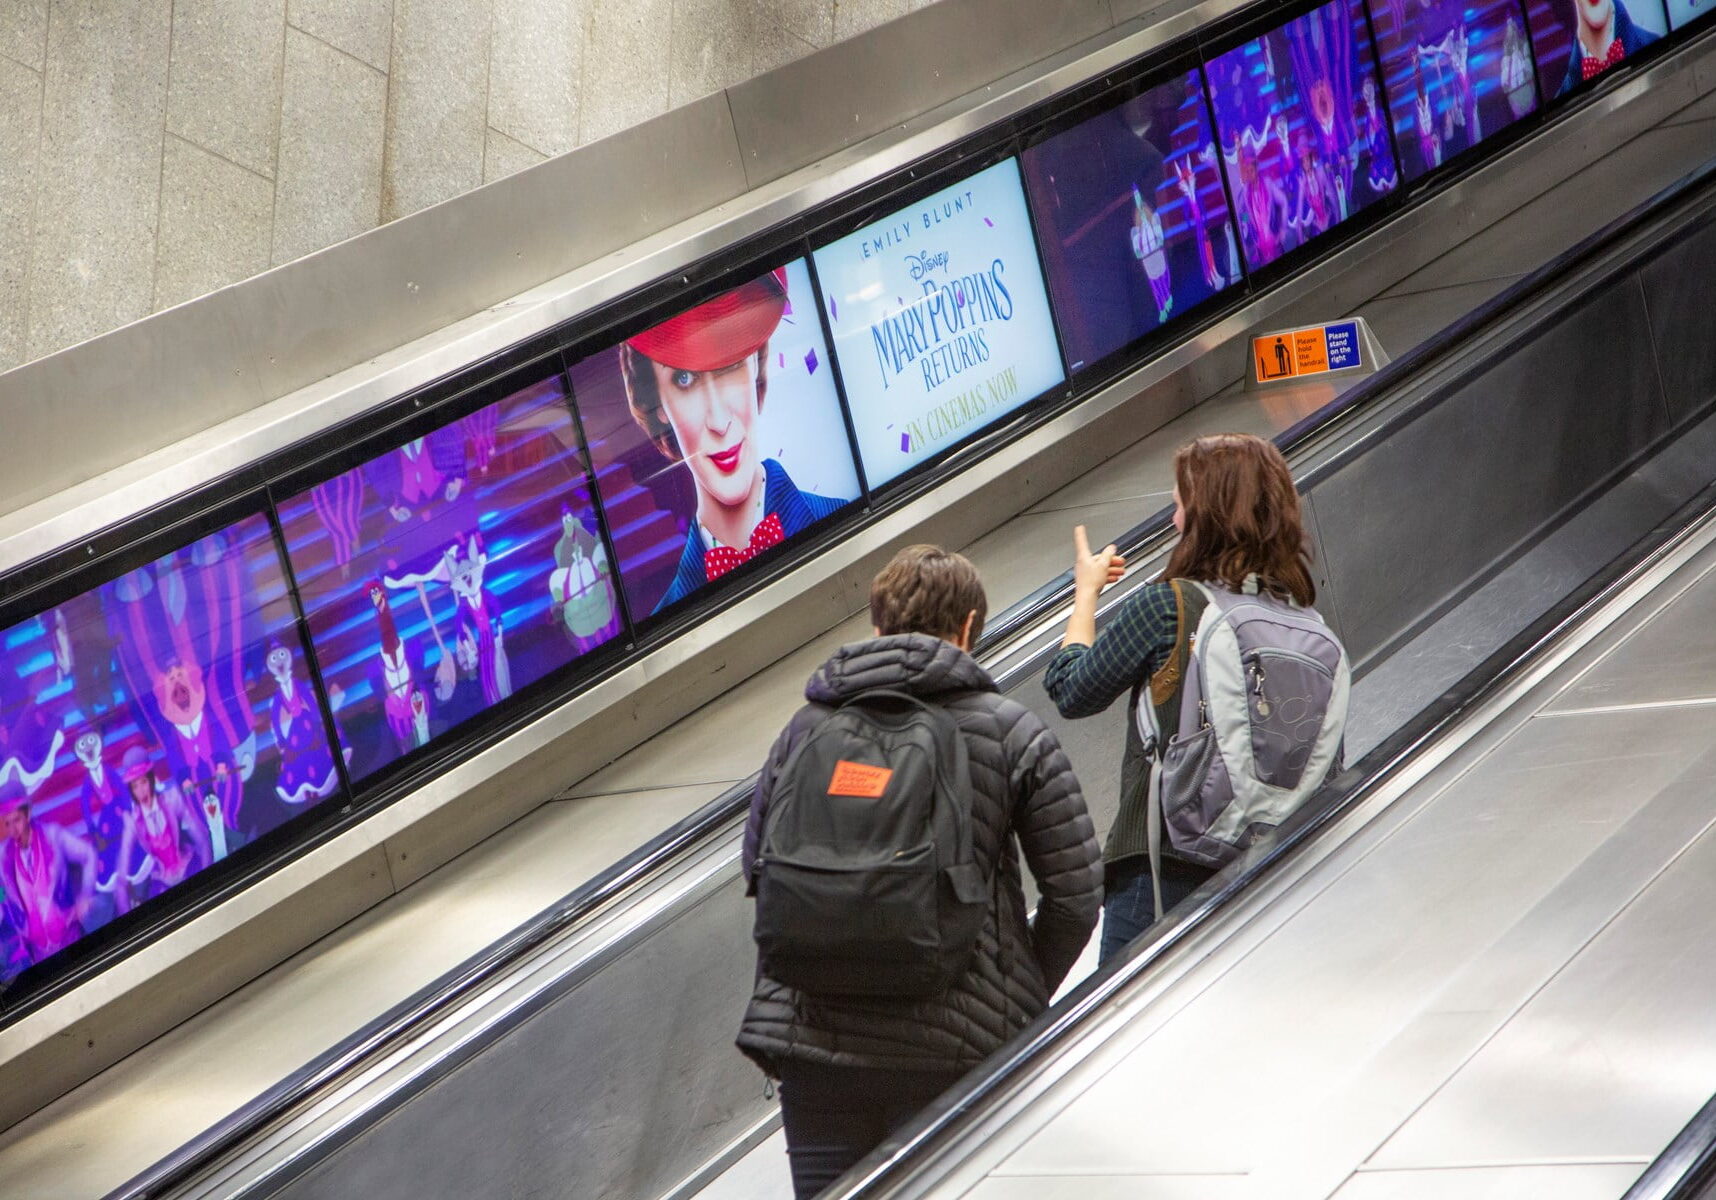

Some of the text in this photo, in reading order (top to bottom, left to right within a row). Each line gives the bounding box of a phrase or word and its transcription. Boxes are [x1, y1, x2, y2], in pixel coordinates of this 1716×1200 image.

[862, 191, 974, 258] EMILY BLUNT
[871, 258, 1014, 389] MARY POPPINS
[1328, 332, 1349, 340] Please
[1329, 339, 1348, 347] stand
[1298, 345, 1312, 353] hold
[920, 327, 990, 392] RETURNS
[1299, 358, 1325, 367] handrail
[1331, 355, 1347, 364] right
[905, 365, 1018, 452] IN CINEMAS NOW
